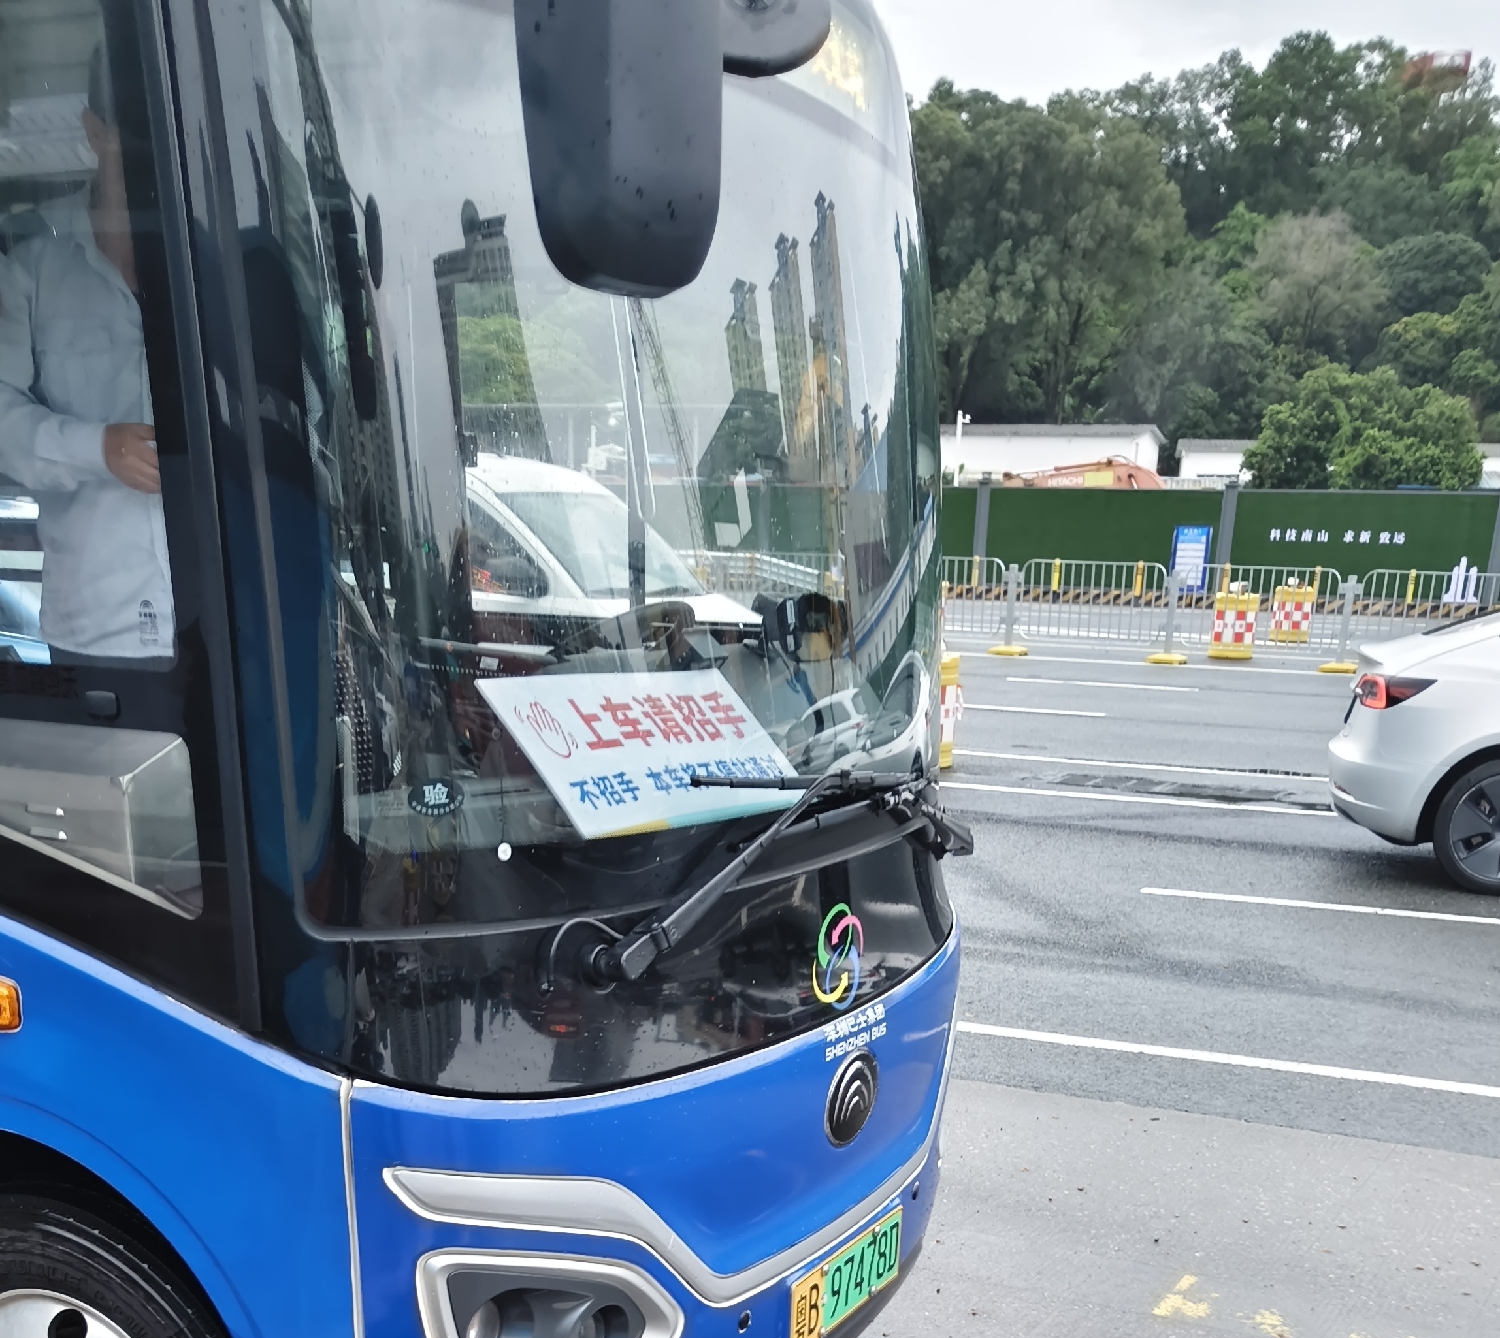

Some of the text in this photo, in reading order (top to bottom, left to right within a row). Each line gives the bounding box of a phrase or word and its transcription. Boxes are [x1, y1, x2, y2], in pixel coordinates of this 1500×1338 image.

[567, 691, 747, 750] 上车请招手
[423, 783, 450, 806] 验
[569, 771, 640, 810] 不招手
[825, 1022, 887, 1062] SHENZHEN BUS
